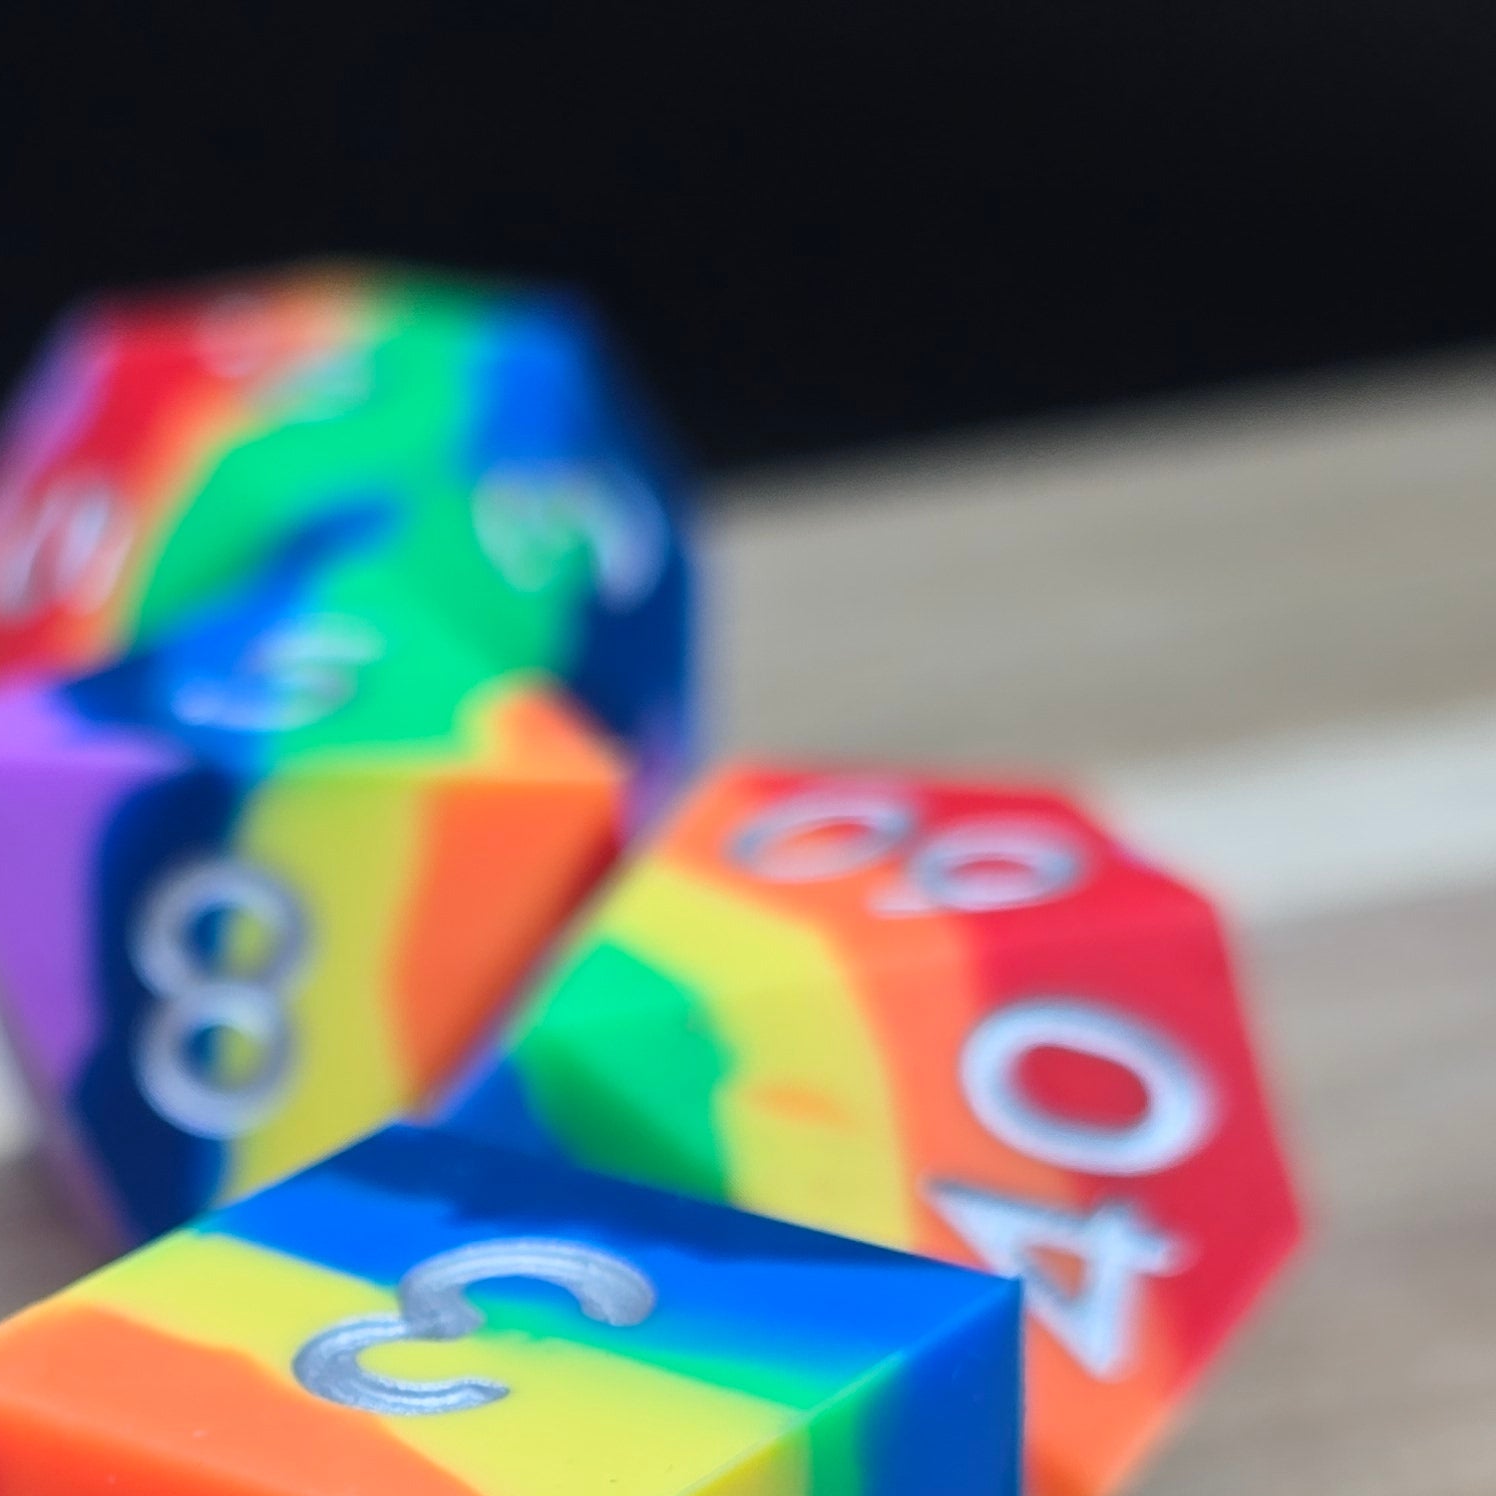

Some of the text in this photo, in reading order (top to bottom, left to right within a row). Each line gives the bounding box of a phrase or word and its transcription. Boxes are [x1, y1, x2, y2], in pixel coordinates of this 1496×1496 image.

[126, 858, 307, 1140] 8
[292, 1238, 656, 1416] 3
[922, 1000, 1219, 1380] 40
